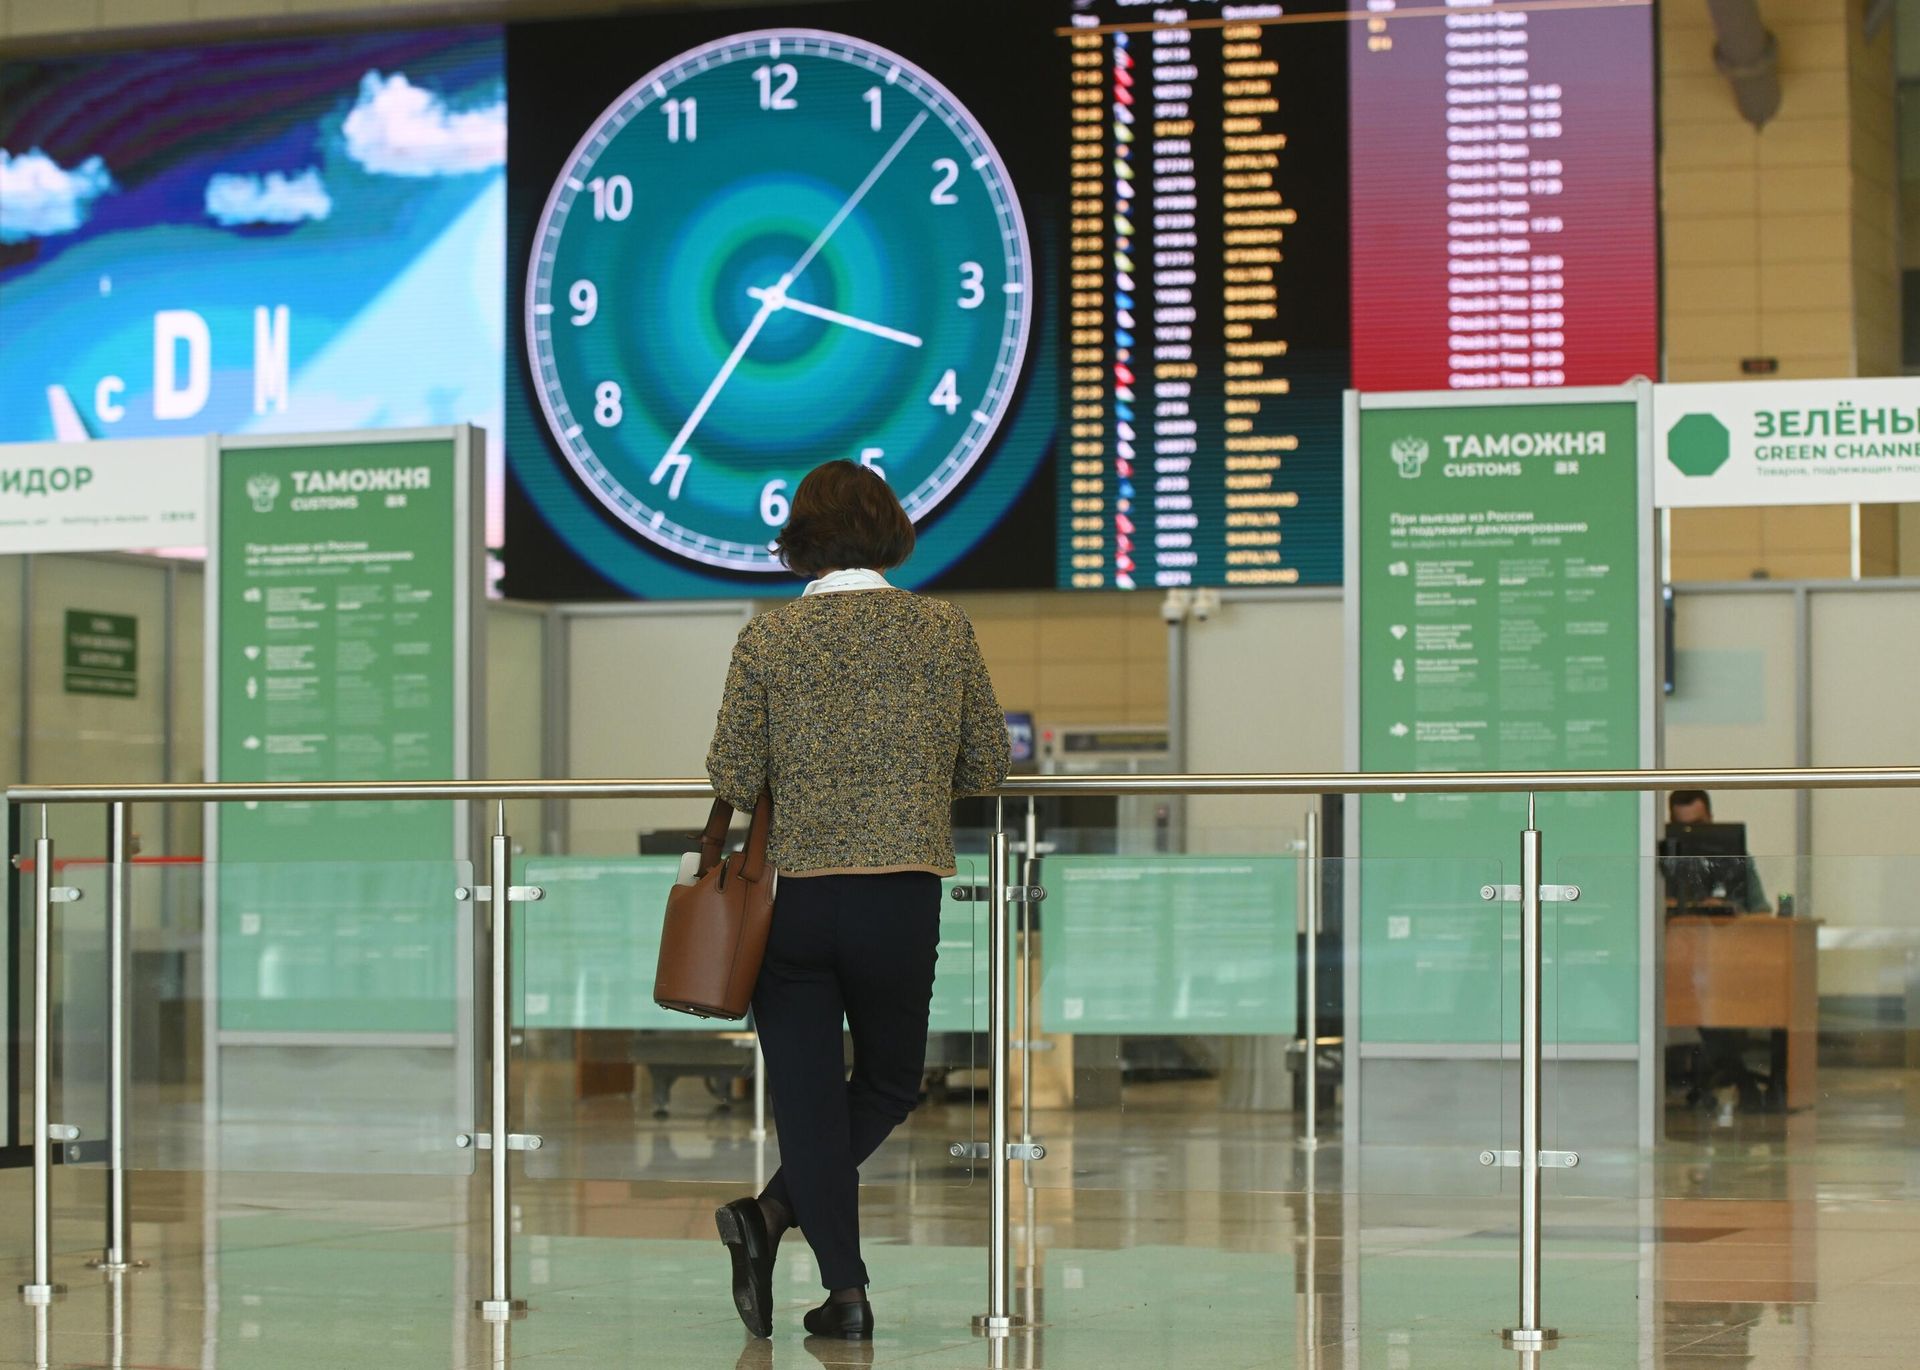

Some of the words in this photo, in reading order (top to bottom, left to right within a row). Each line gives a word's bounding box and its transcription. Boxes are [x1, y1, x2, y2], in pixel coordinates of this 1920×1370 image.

[752, 64, 798, 110] 12
[863, 87, 882, 131] 1
[661, 97, 697, 143] 11
[588, 175, 633, 222] 10
[930, 158, 960, 205] 2
[569, 279, 599, 327] 9
[957, 261, 986, 310] 3
[594, 380, 623, 428] 8
[928, 369, 962, 415] 4
[1443, 431, 1606, 458] ТАМОЖНЯ
[1754, 444, 1827, 461] GREEN
[0, 467, 93, 496] ИДОР
[291, 467, 431, 493] ТАМОЖНЯ
[663, 453, 692, 501] 7
[1443, 461, 1522, 477] CUSTOMS
[290, 496, 358, 511] CUSTOMS
[759, 479, 789, 526] 6
